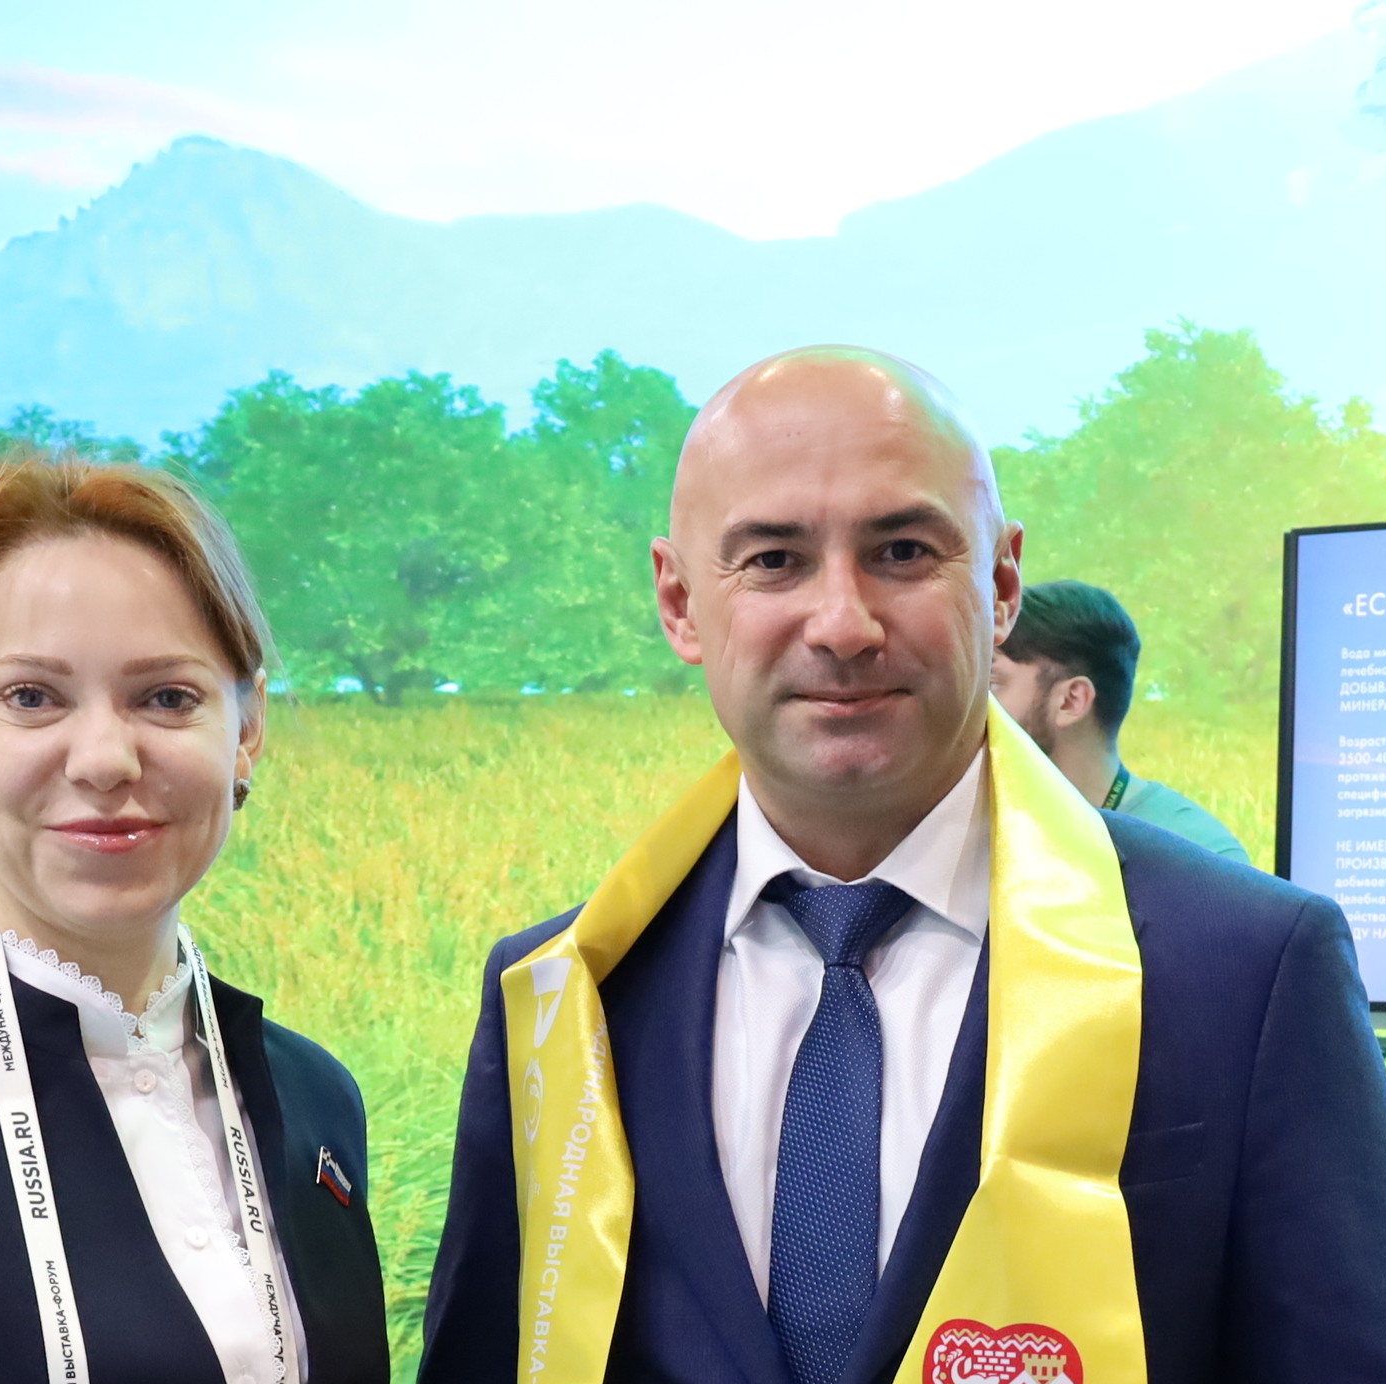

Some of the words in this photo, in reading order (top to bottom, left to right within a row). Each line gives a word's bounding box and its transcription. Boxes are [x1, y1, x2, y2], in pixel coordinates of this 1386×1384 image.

[1341, 648, 1370, 659] Вода
[1339, 735, 1386, 749] Возраст
[1336, 841, 1352, 851] НЕ
[1352, 928, 1368, 941] ДУ
[11, 1111, 48, 1220] RUSSIA.RU
[230, 1125, 264, 1234] RUSSIA.RU
[46, 1259, 77, 1378] ВЫСТАВКА-ФОРУМ
